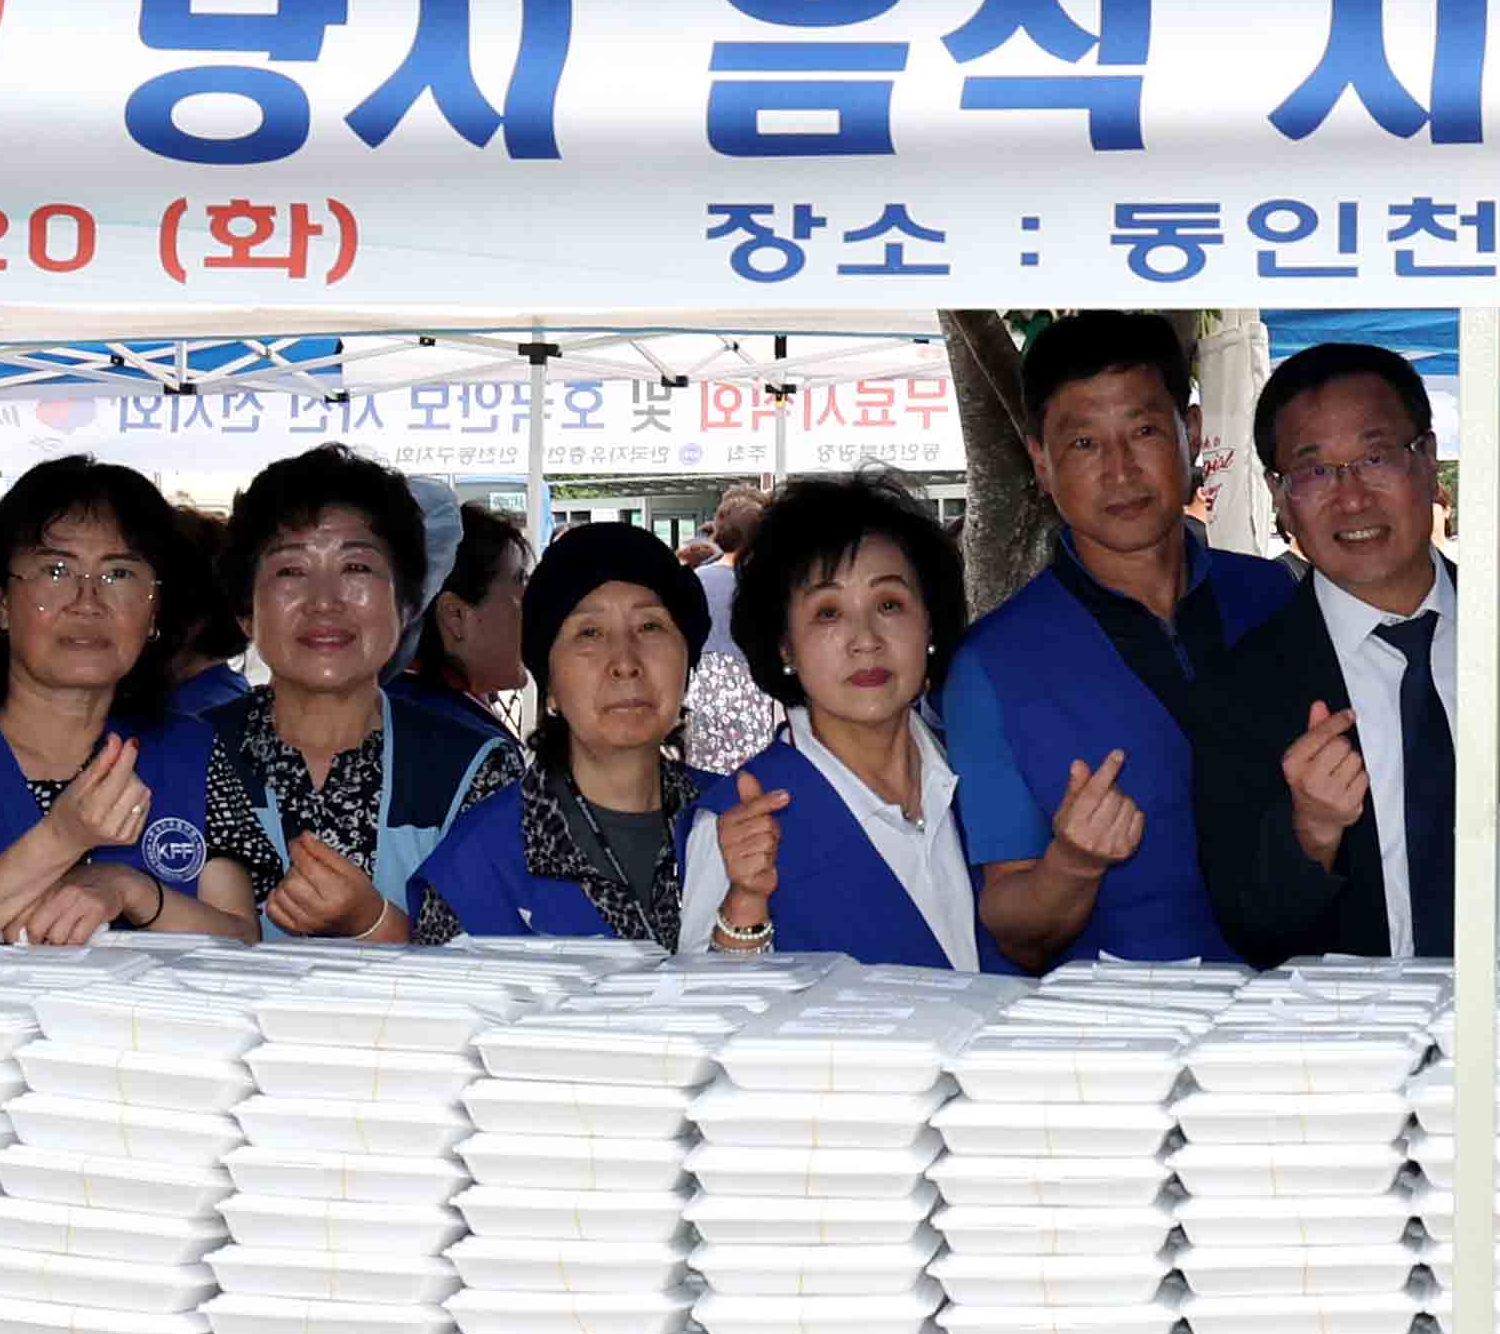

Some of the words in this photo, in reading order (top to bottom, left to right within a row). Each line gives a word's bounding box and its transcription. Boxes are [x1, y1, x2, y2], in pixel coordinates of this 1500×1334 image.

[159, 197, 358, 284] (화)
[705, 200, 950, 284] 장소
[156, 841, 197, 860] KFF
